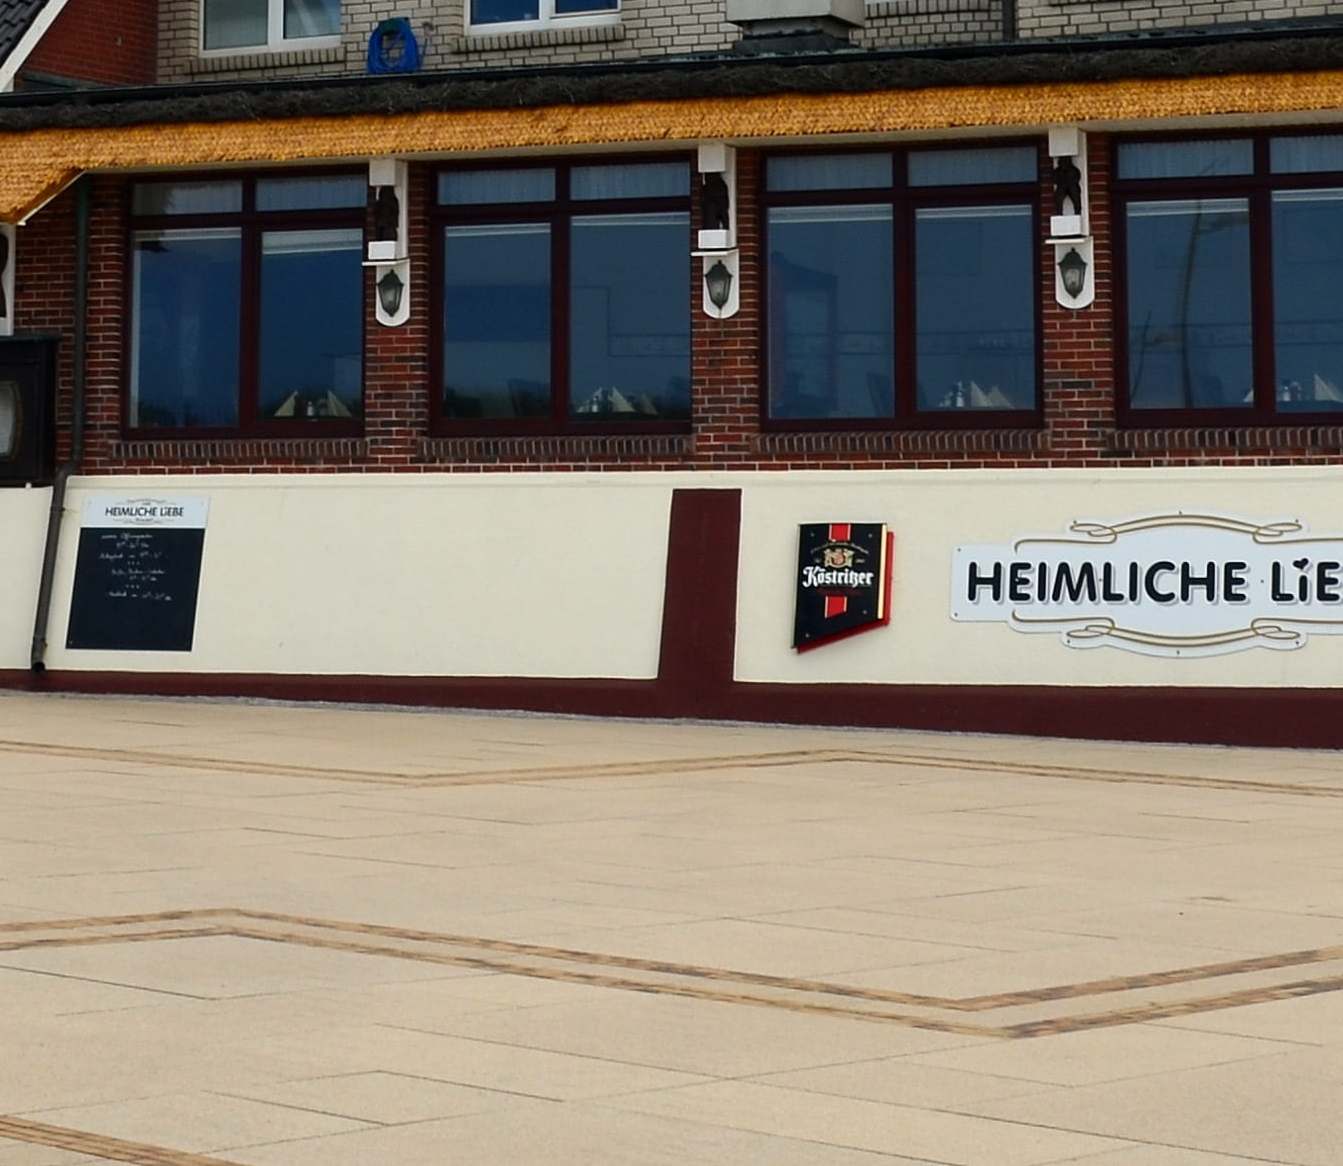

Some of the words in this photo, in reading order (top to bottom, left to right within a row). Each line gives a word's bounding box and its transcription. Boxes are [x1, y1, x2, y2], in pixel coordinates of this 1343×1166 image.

[105, 507, 157, 516] HEIMLICHE
[802, 566, 874, 588] Köstritzer
[967, 561, 1248, 602] HEIMLICHE
